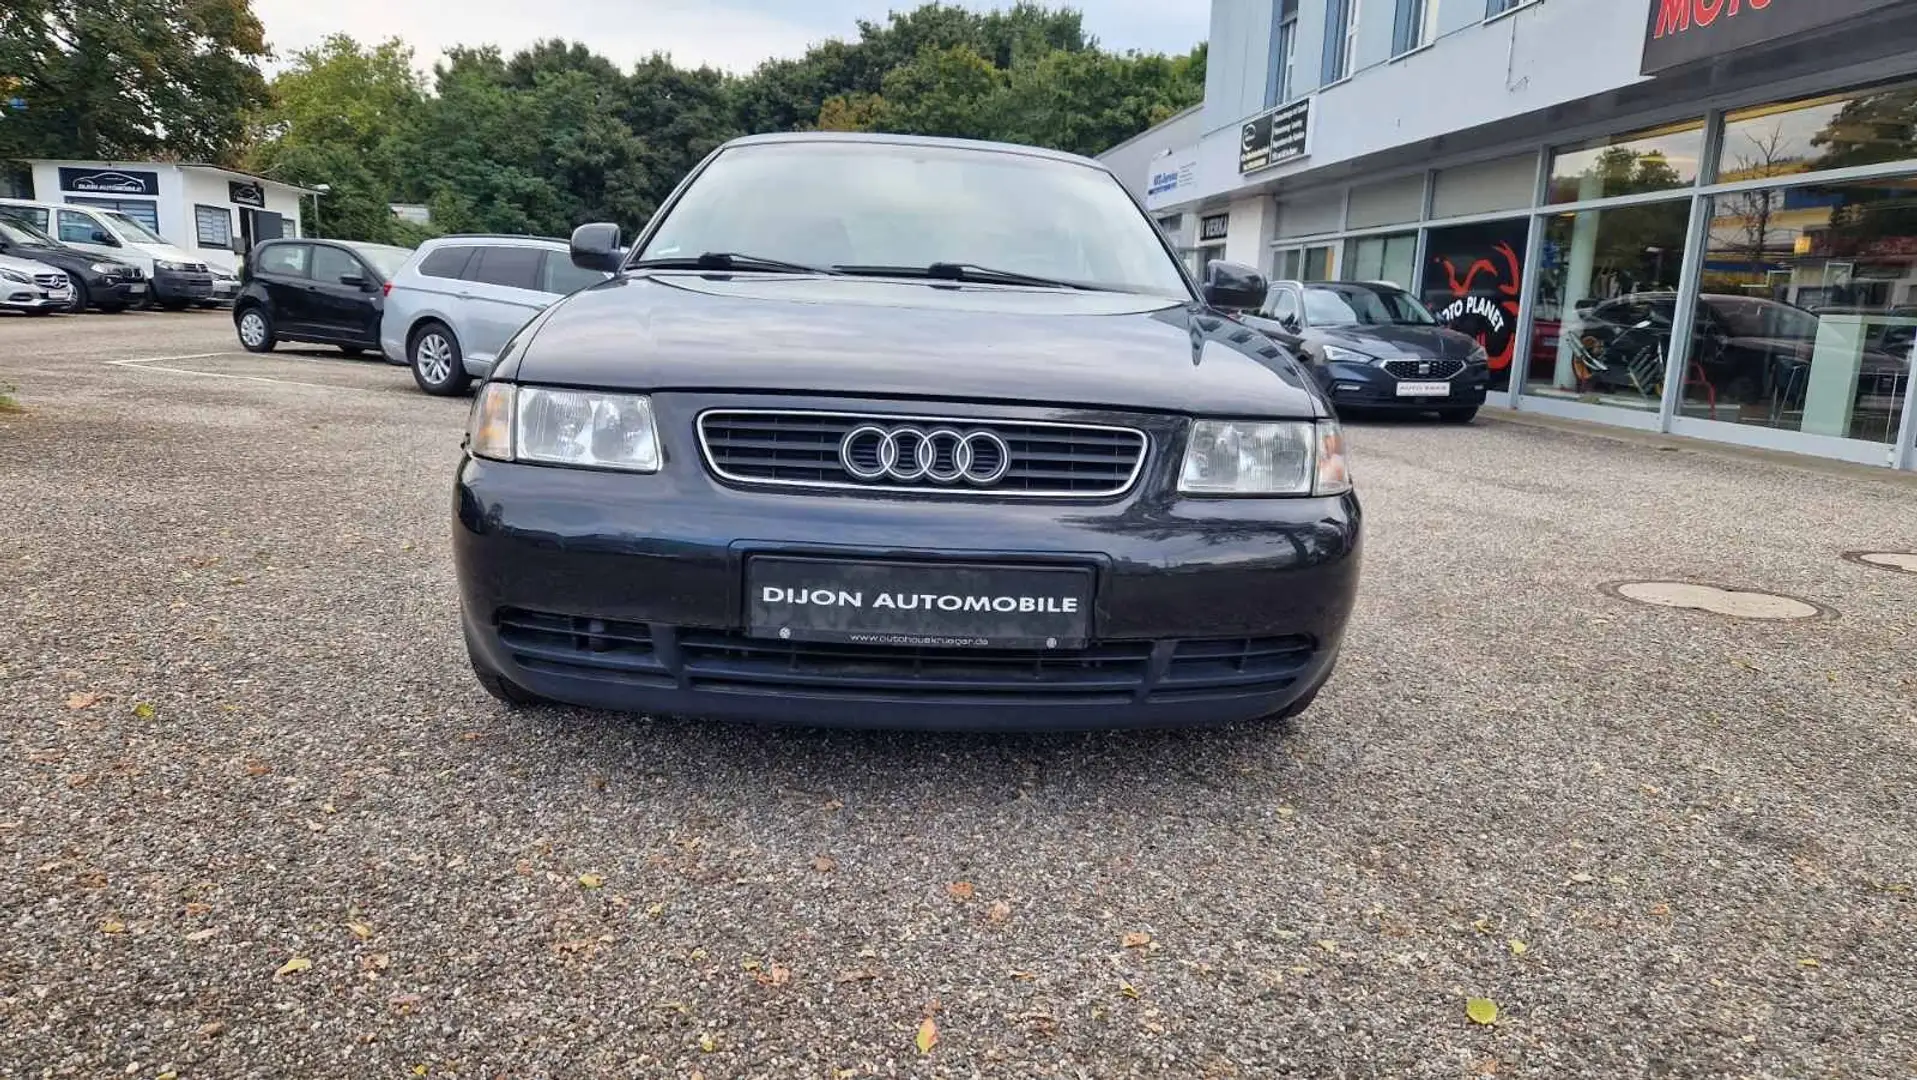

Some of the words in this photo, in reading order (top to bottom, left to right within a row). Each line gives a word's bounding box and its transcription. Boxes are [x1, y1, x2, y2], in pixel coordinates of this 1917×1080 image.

[1442, 299, 1463, 321] OTO
[1466, 296, 1504, 332] PLANET
[763, 586, 862, 607] DIJON
[872, 592, 1078, 613] AUTOMOBILE
